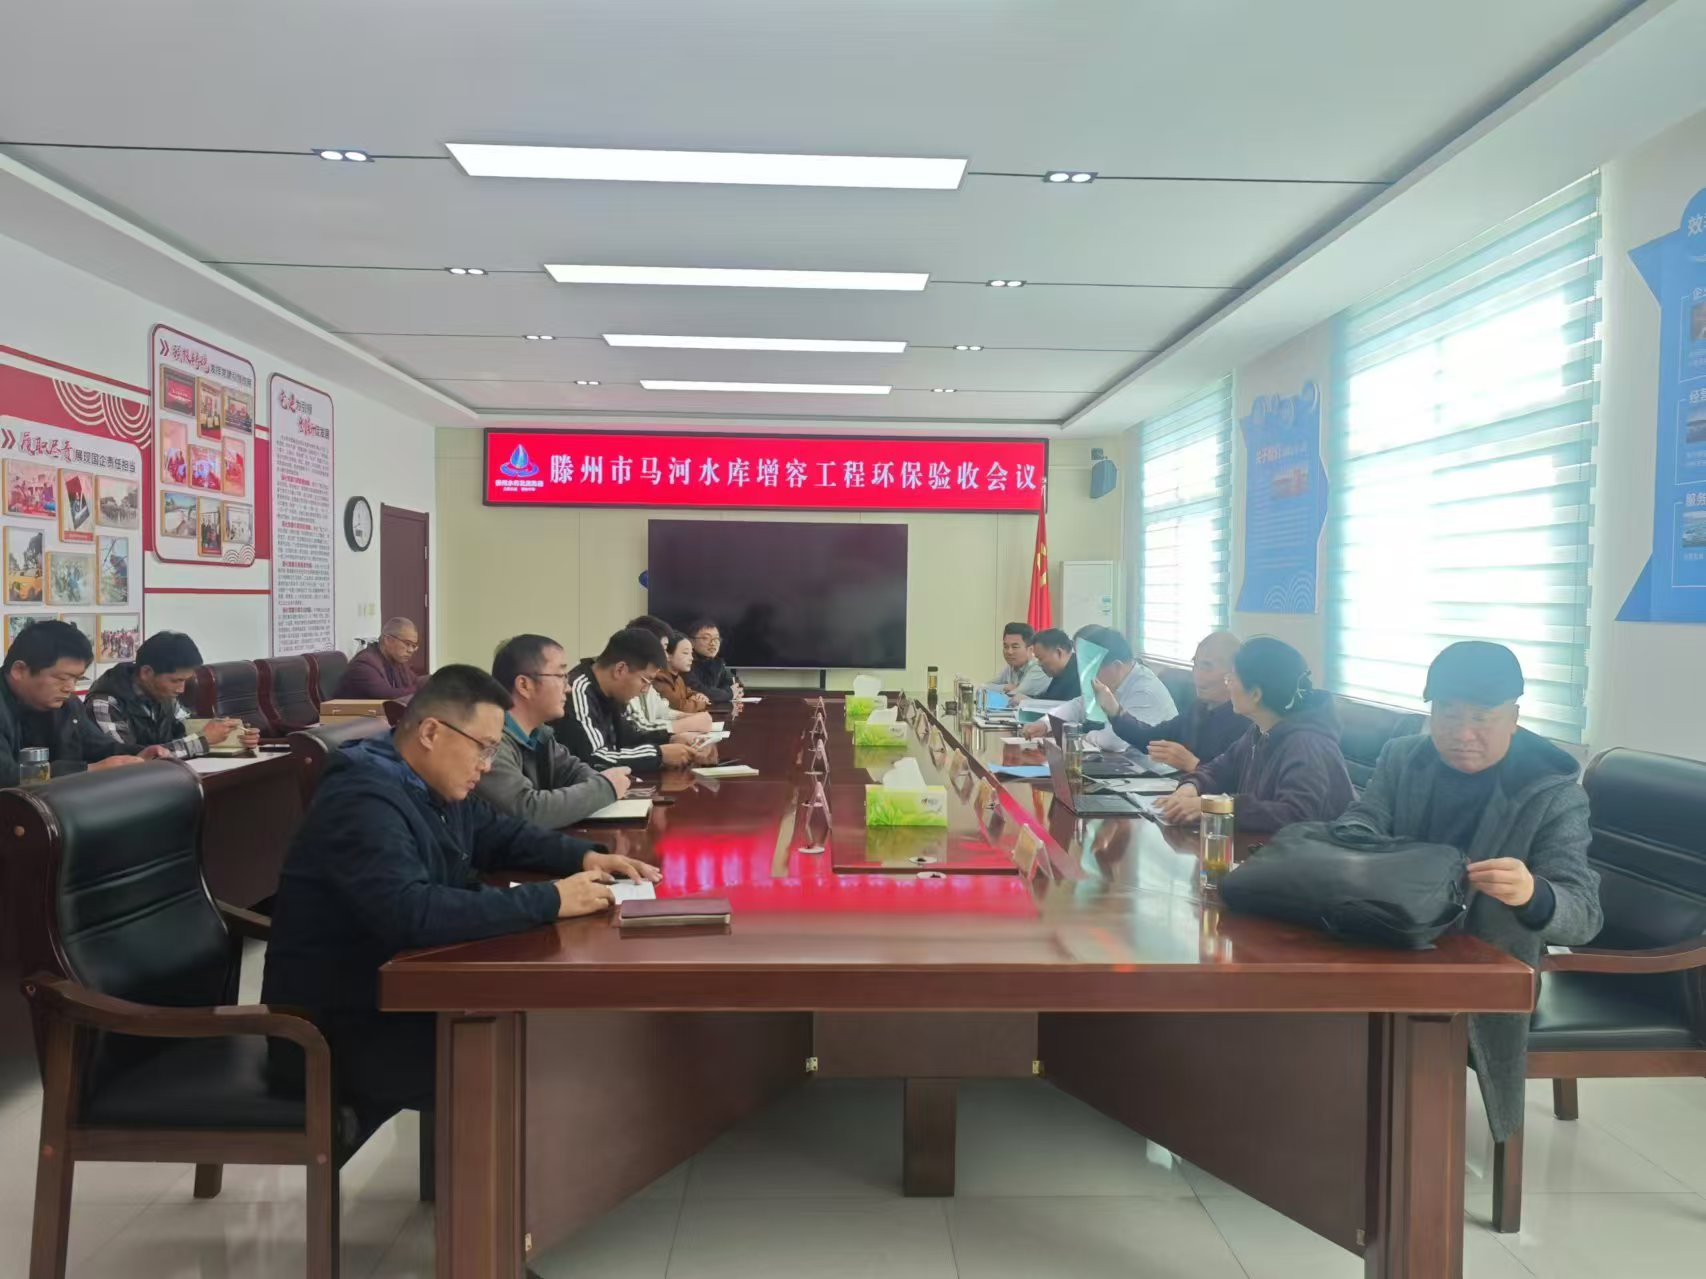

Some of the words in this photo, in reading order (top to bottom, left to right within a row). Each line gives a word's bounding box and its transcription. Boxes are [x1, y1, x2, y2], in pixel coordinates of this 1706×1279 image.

[1688, 213, 1706, 238] 效
[1691, 287, 1706, 300] 企
[550, 454, 1037, 491] 滕州市马河水库增容工程环保验收会议
